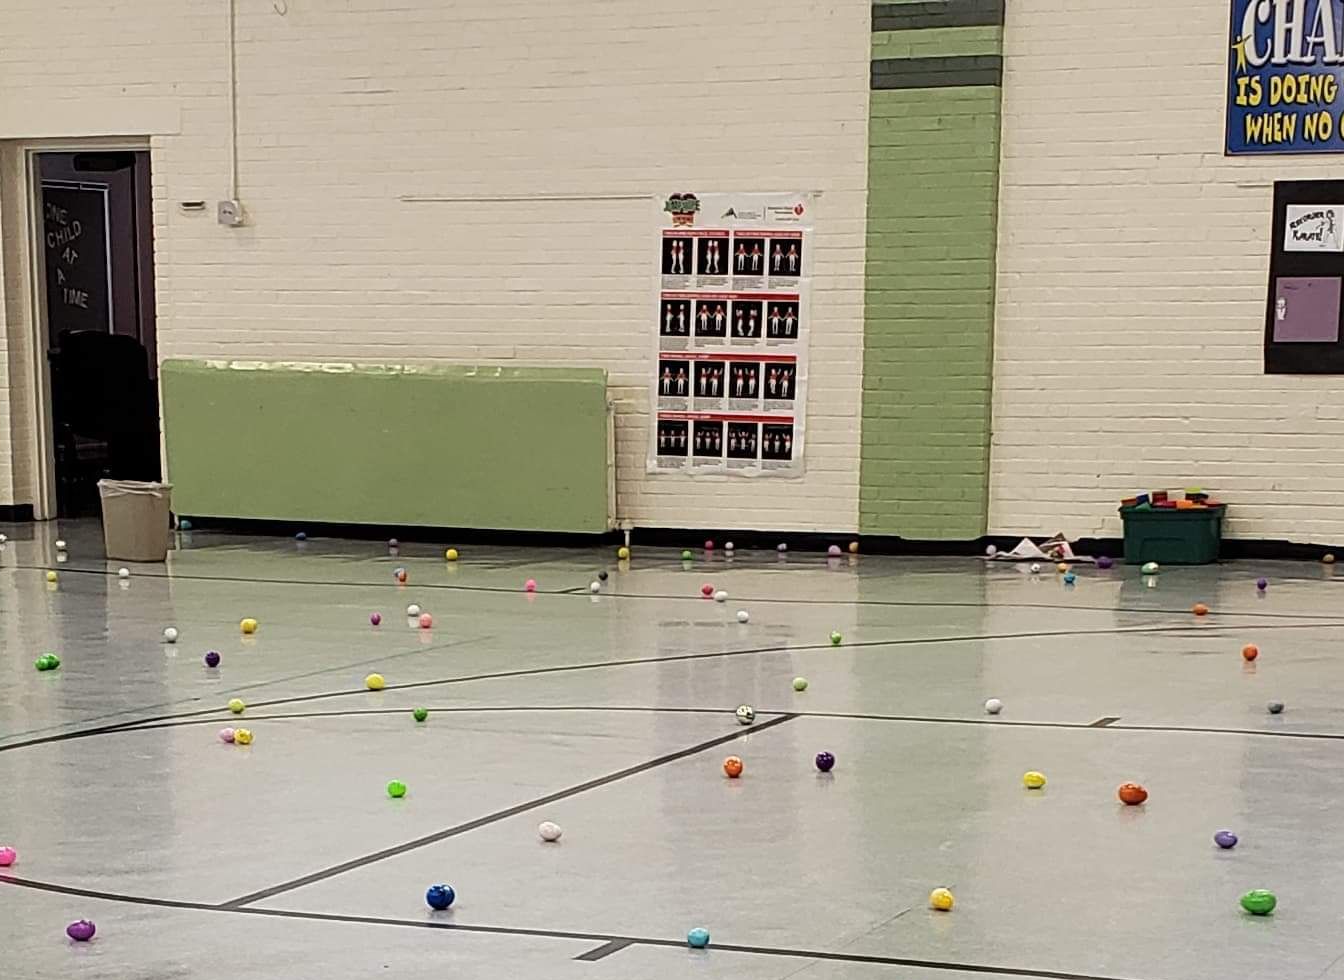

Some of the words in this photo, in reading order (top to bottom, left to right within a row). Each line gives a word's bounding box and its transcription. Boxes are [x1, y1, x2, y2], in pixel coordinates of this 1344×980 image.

[1236, 76, 1262, 106] IS
[1269, 75, 1338, 106] DOING
[1245, 113, 1296, 144] WHEN
[1304, 112, 1333, 141] NO
[47, 220, 81, 248] CHILD
